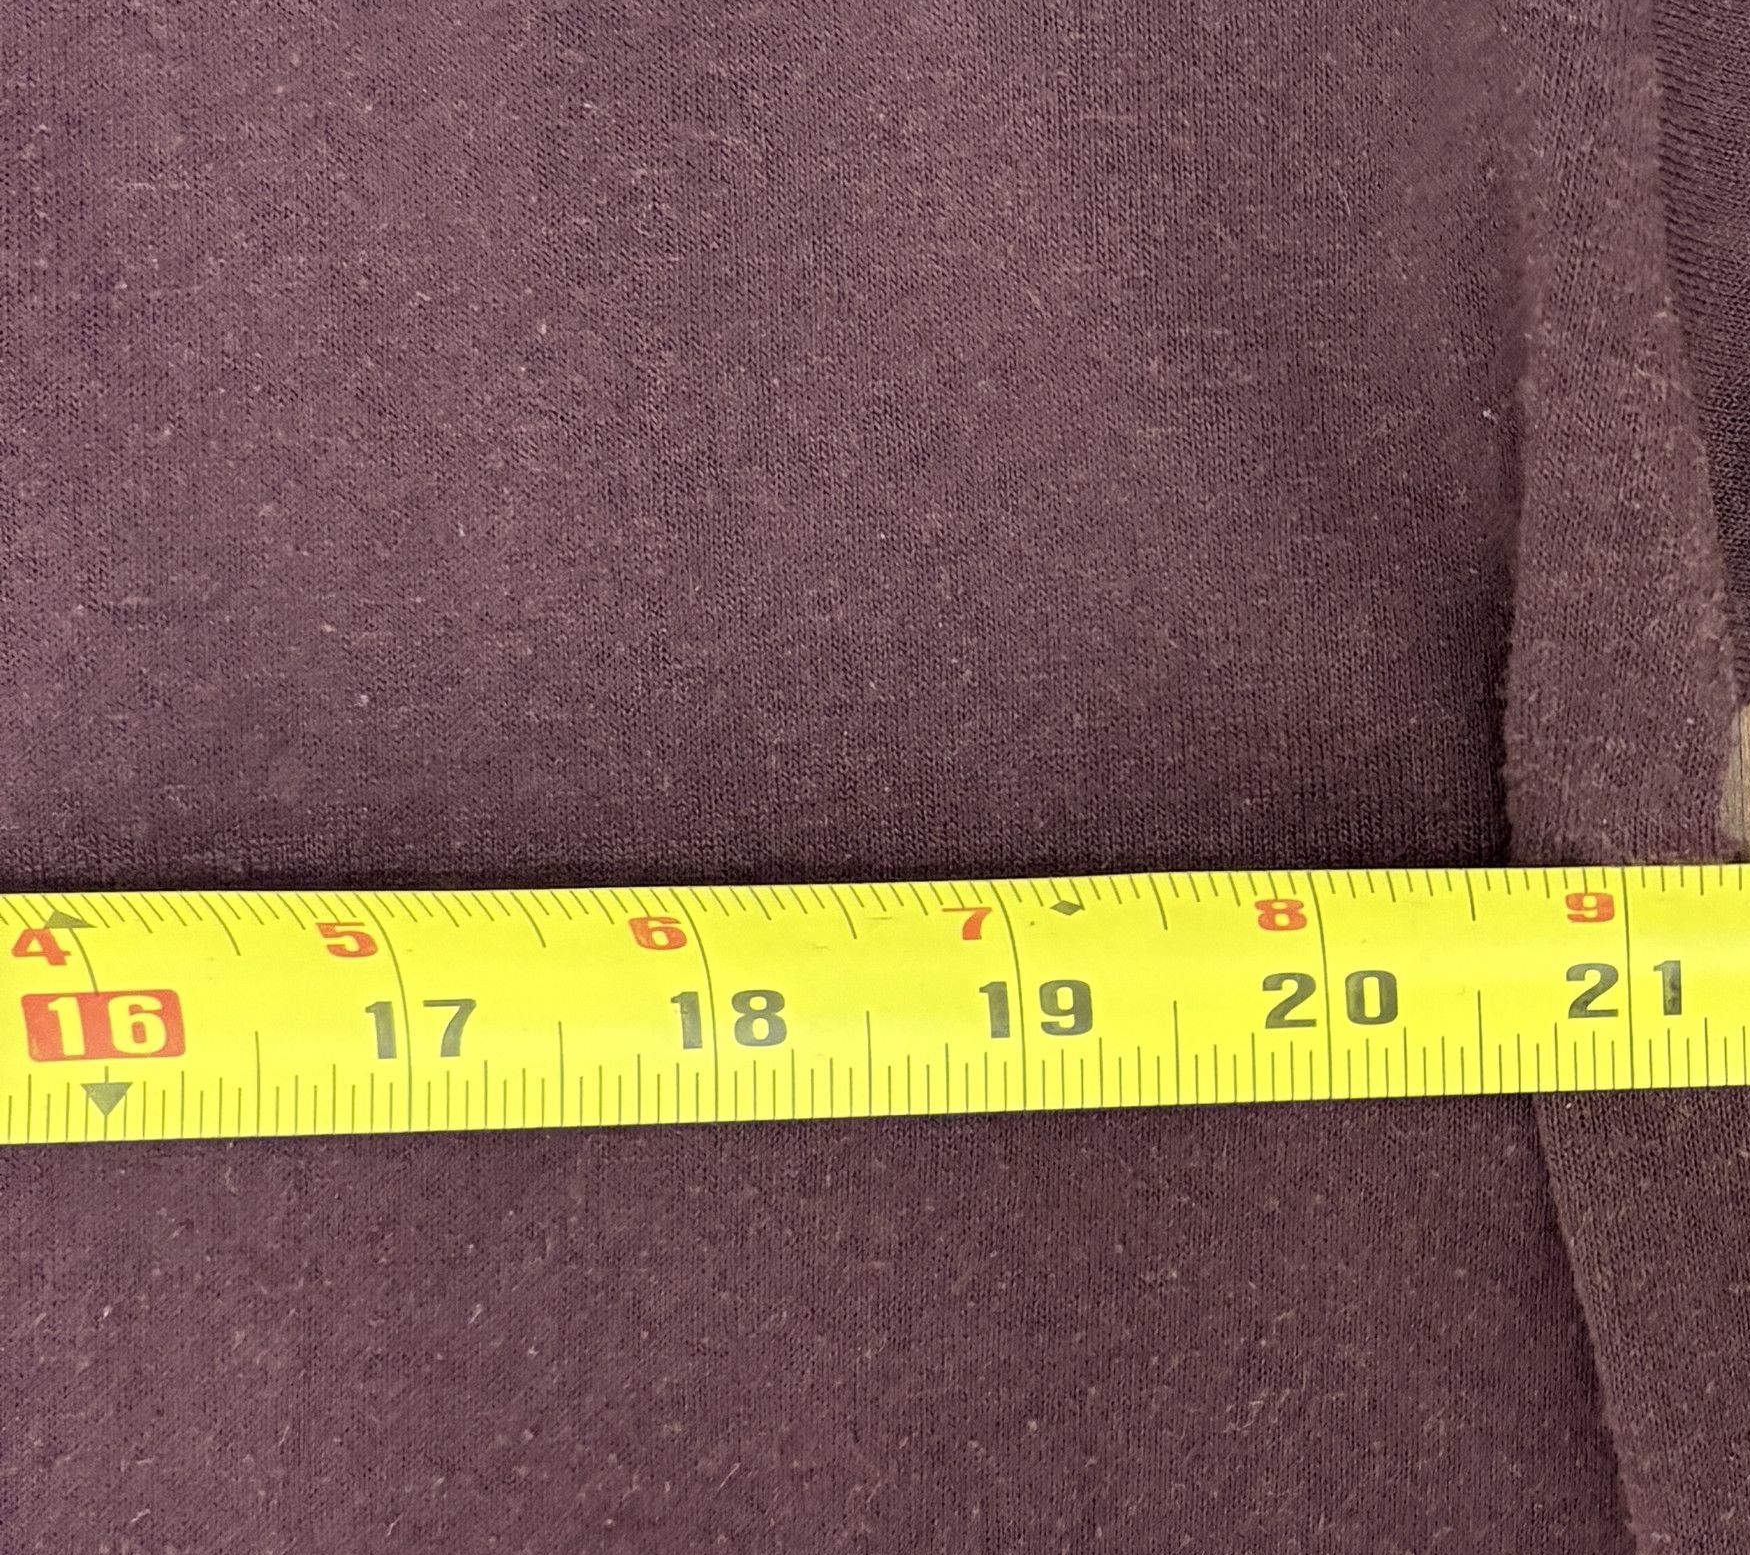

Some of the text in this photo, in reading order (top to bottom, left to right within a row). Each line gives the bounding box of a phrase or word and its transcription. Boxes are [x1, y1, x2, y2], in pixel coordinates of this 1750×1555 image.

[11, 928, 72, 966] 4
[315, 922, 379, 957] 5
[628, 917, 687, 950] 6
[942, 907, 993, 940] 7
[1254, 899, 1308, 931] 8
[1565, 892, 1615, 923] 9
[45, 995, 167, 1056] 16
[364, 998, 477, 1060] 17
[668, 989, 787, 1050] 18
[978, 979, 1093, 1039] 19
[1261, 969, 1398, 1030] 20
[1565, 960, 1683, 1020] 21
